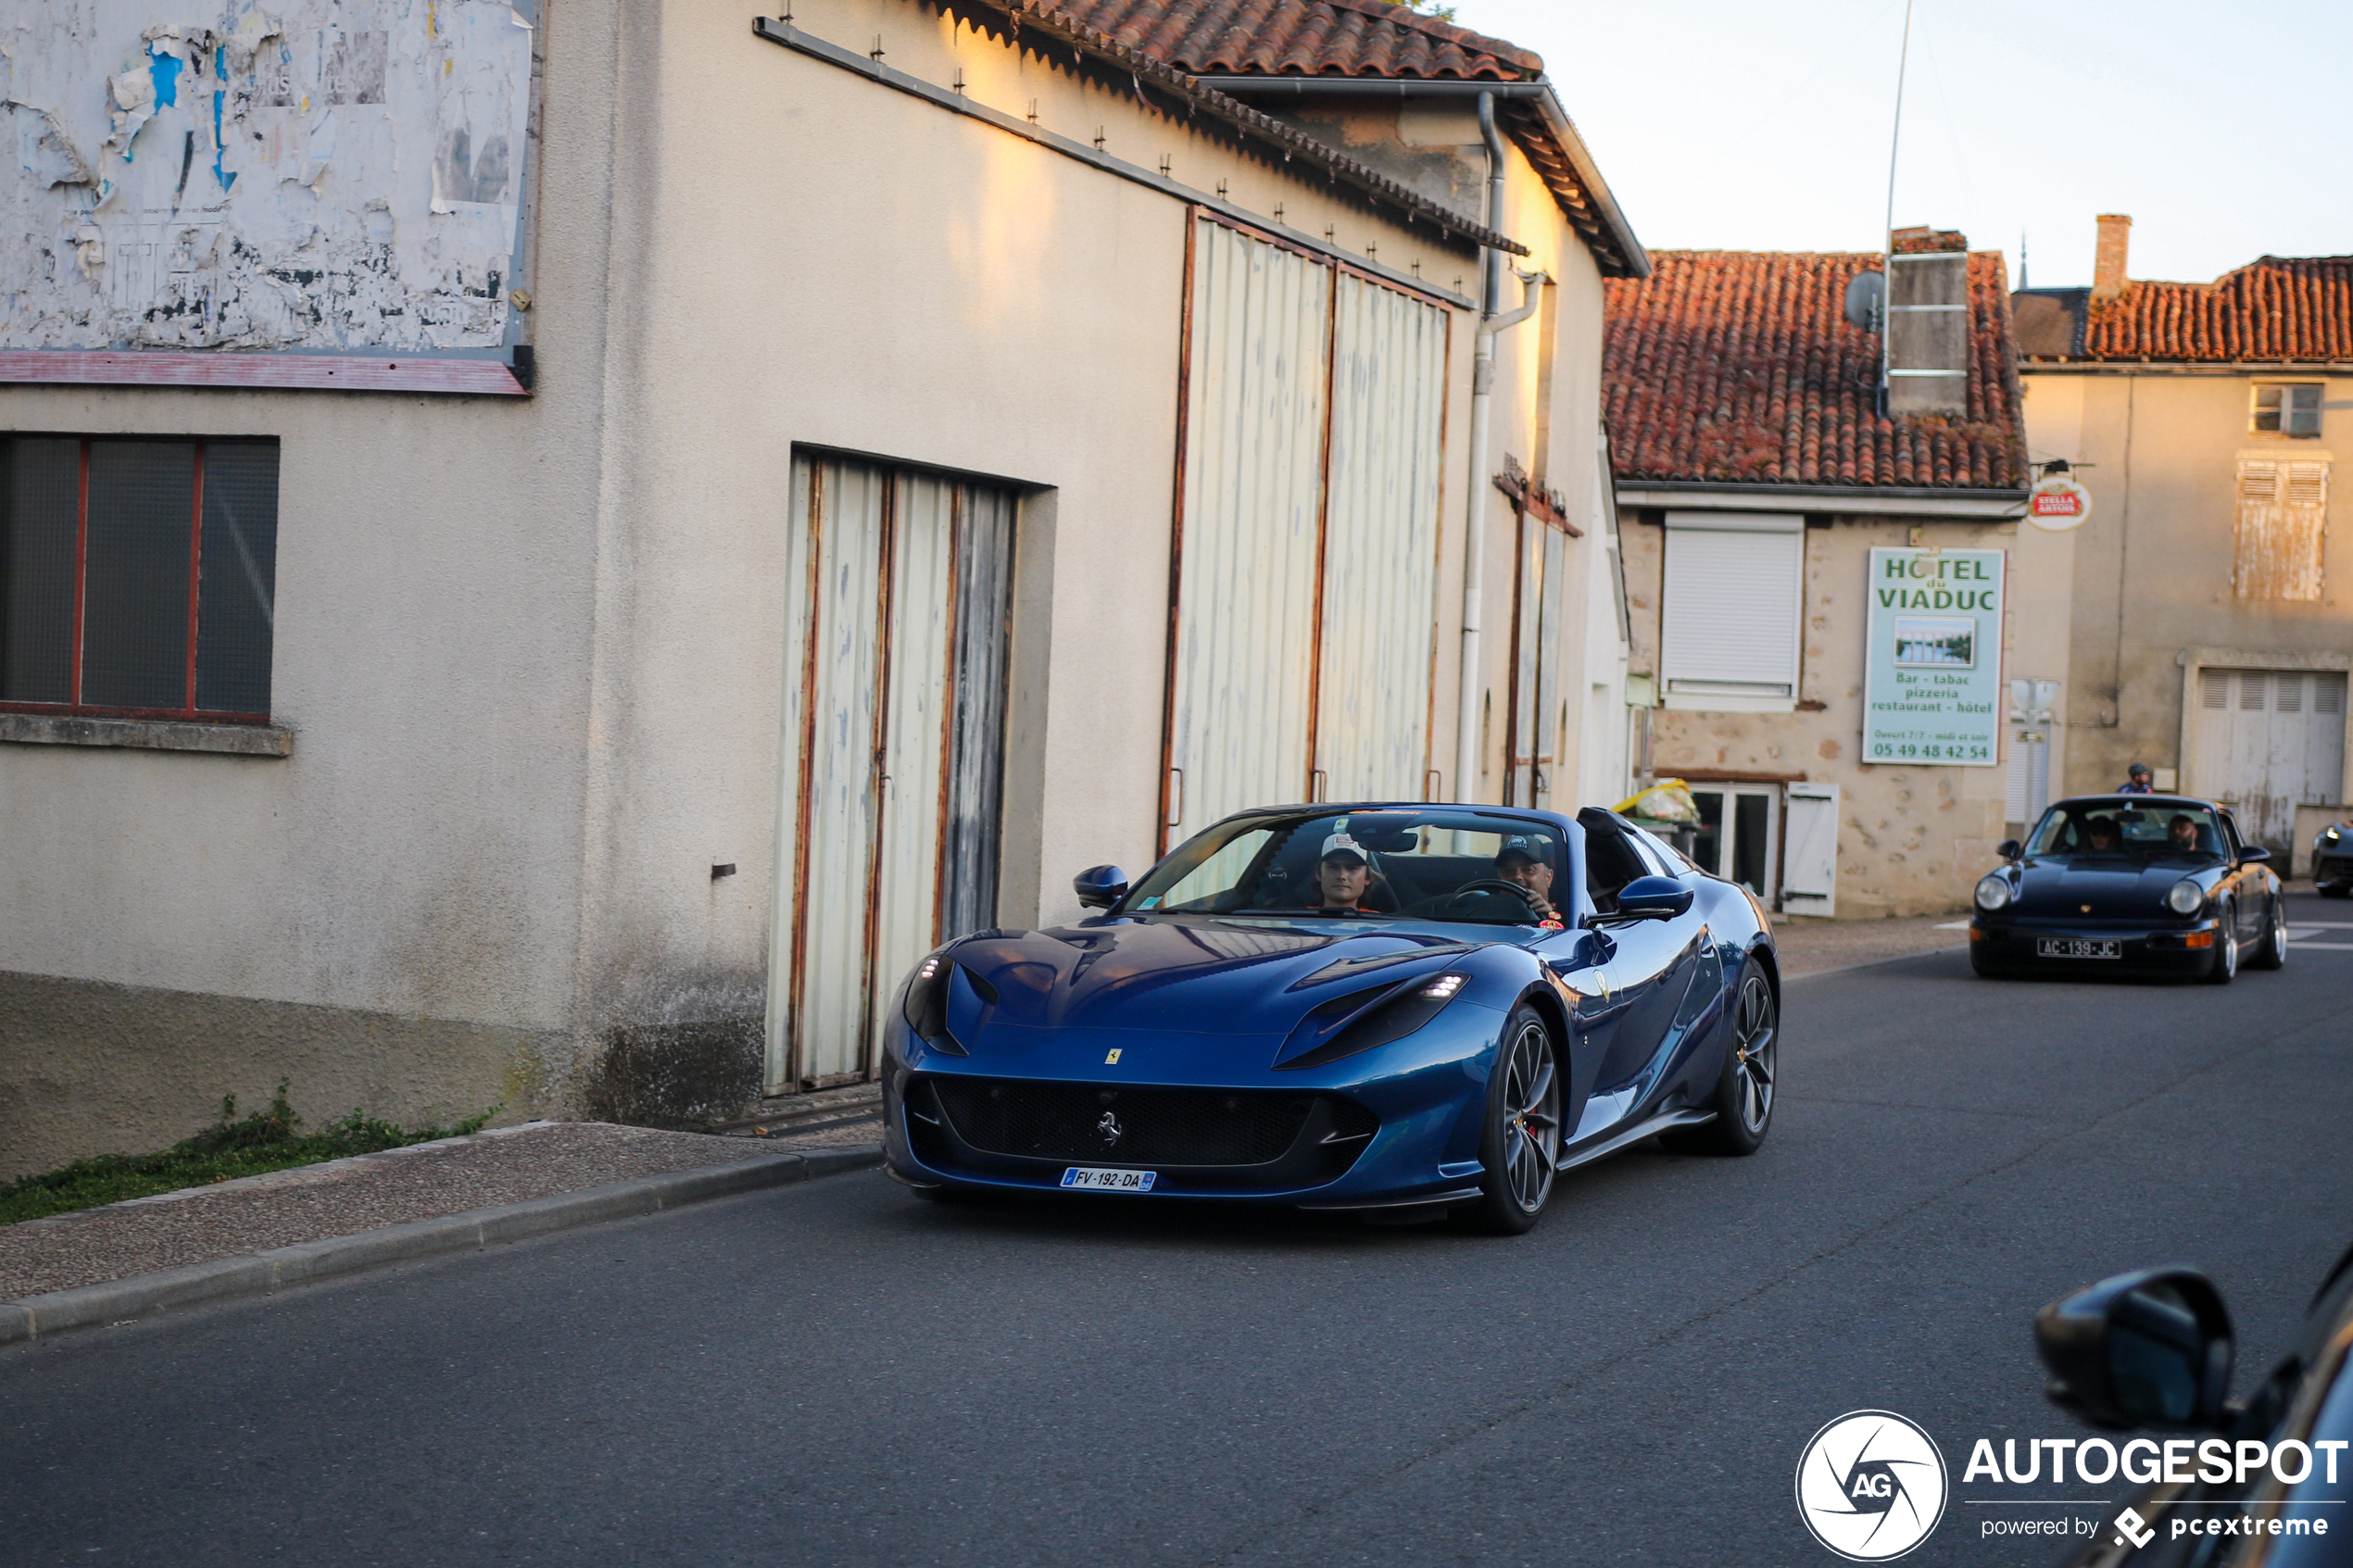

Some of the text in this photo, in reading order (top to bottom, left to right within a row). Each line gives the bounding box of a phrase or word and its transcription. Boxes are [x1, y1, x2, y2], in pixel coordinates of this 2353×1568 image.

[2038, 495, 2074, 504] STELLA
[2038, 504, 2075, 513] ARTOIS
[1927, 577, 1945, 588] du
[1878, 589, 1994, 610] VIADUC
[1896, 673, 1919, 684] Bar
[1934, 674, 1969, 685] tabac
[1906, 686, 1958, 699] pizzeria
[1872, 701, 1942, 712] restaurant
[1957, 700, 1992, 713] hôtel
[1874, 730, 1906, 739] Ouvert
[1909, 730, 1925, 740] 7/7
[1935, 731, 1956, 740] midi
[1958, 733, 1968, 741] et
[1970, 733, 1989, 741] soir
[1874, 744, 1988, 759] 05 49 48 42 54
[1075, 1172, 1139, 1187] FV-192-DA
